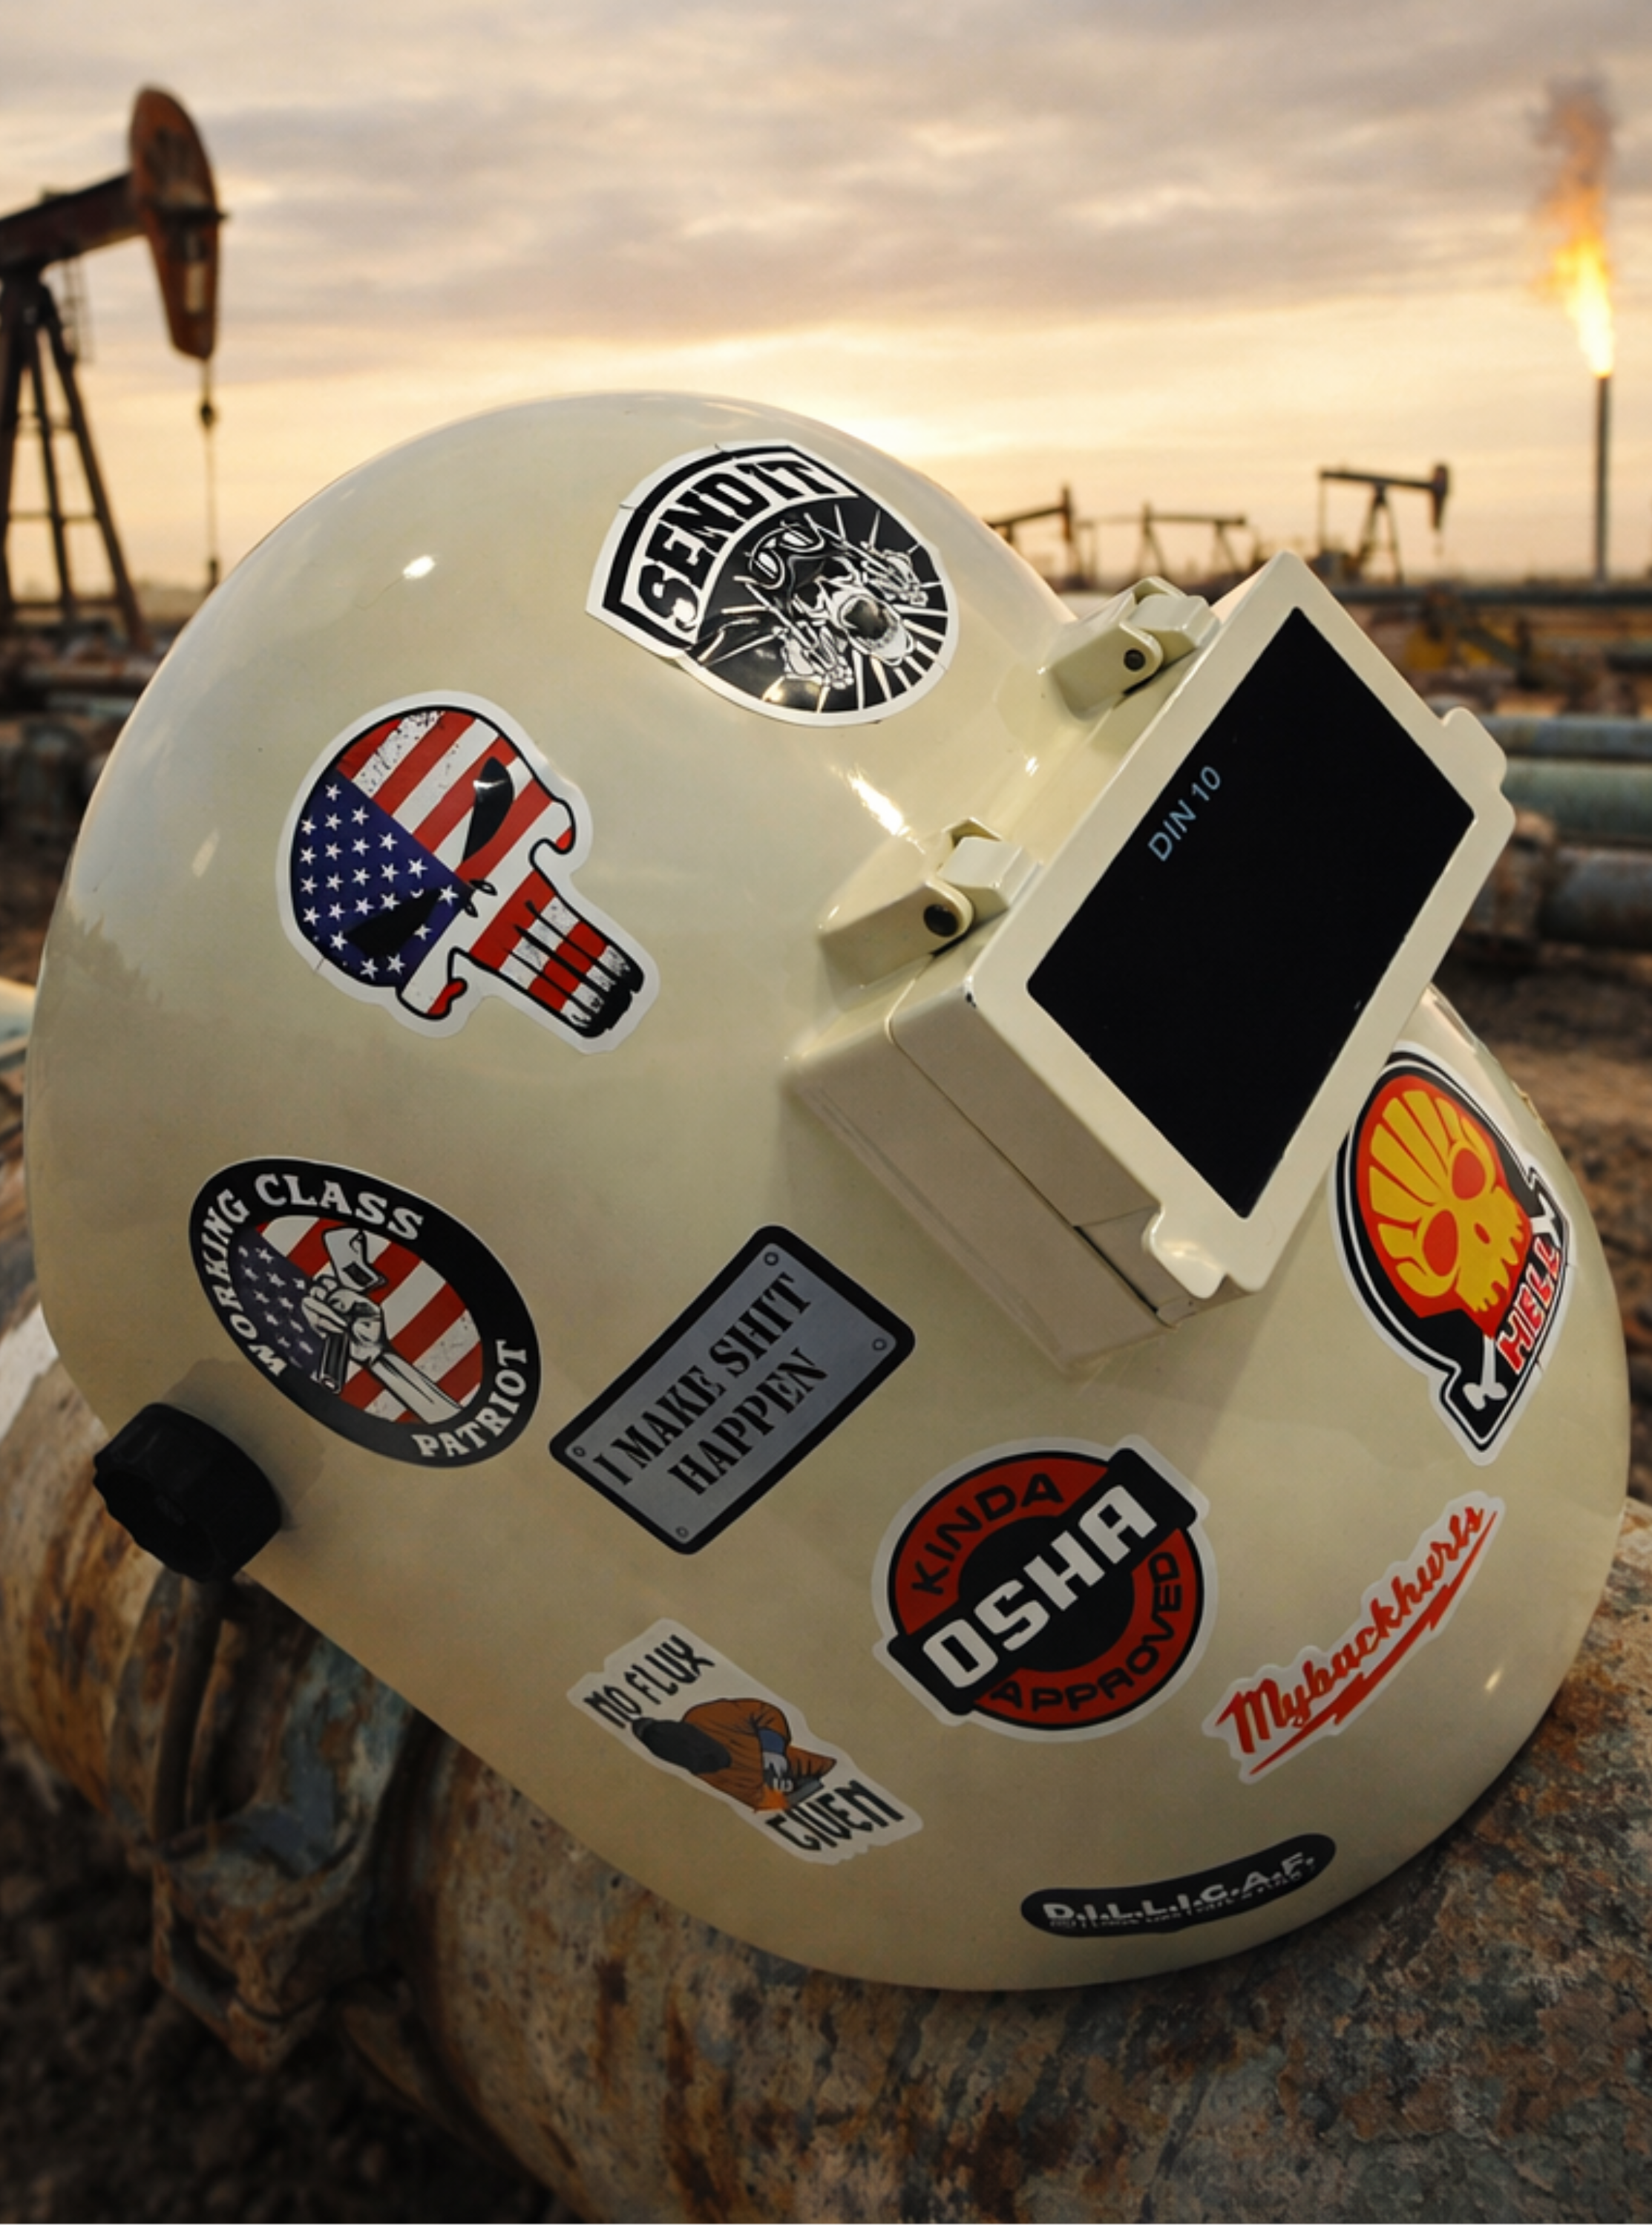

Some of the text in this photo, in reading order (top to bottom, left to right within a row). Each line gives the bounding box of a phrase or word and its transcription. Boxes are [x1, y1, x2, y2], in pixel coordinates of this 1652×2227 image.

[1147, 766, 1221, 862] DIN 10
[201, 1174, 425, 1377] WORKING CLASS
[411, 1340, 528, 1457] PATRIOT
[593, 1272, 811, 1486] I MAKE SHIT
[667, 1348, 828, 1496] HAPPEN
[911, 1473, 1064, 1595] KINDA
[922, 1485, 1158, 1688] OSHA
[624, 1635, 715, 1705] FLUX
[989, 1551, 1183, 1712] APPROVED
